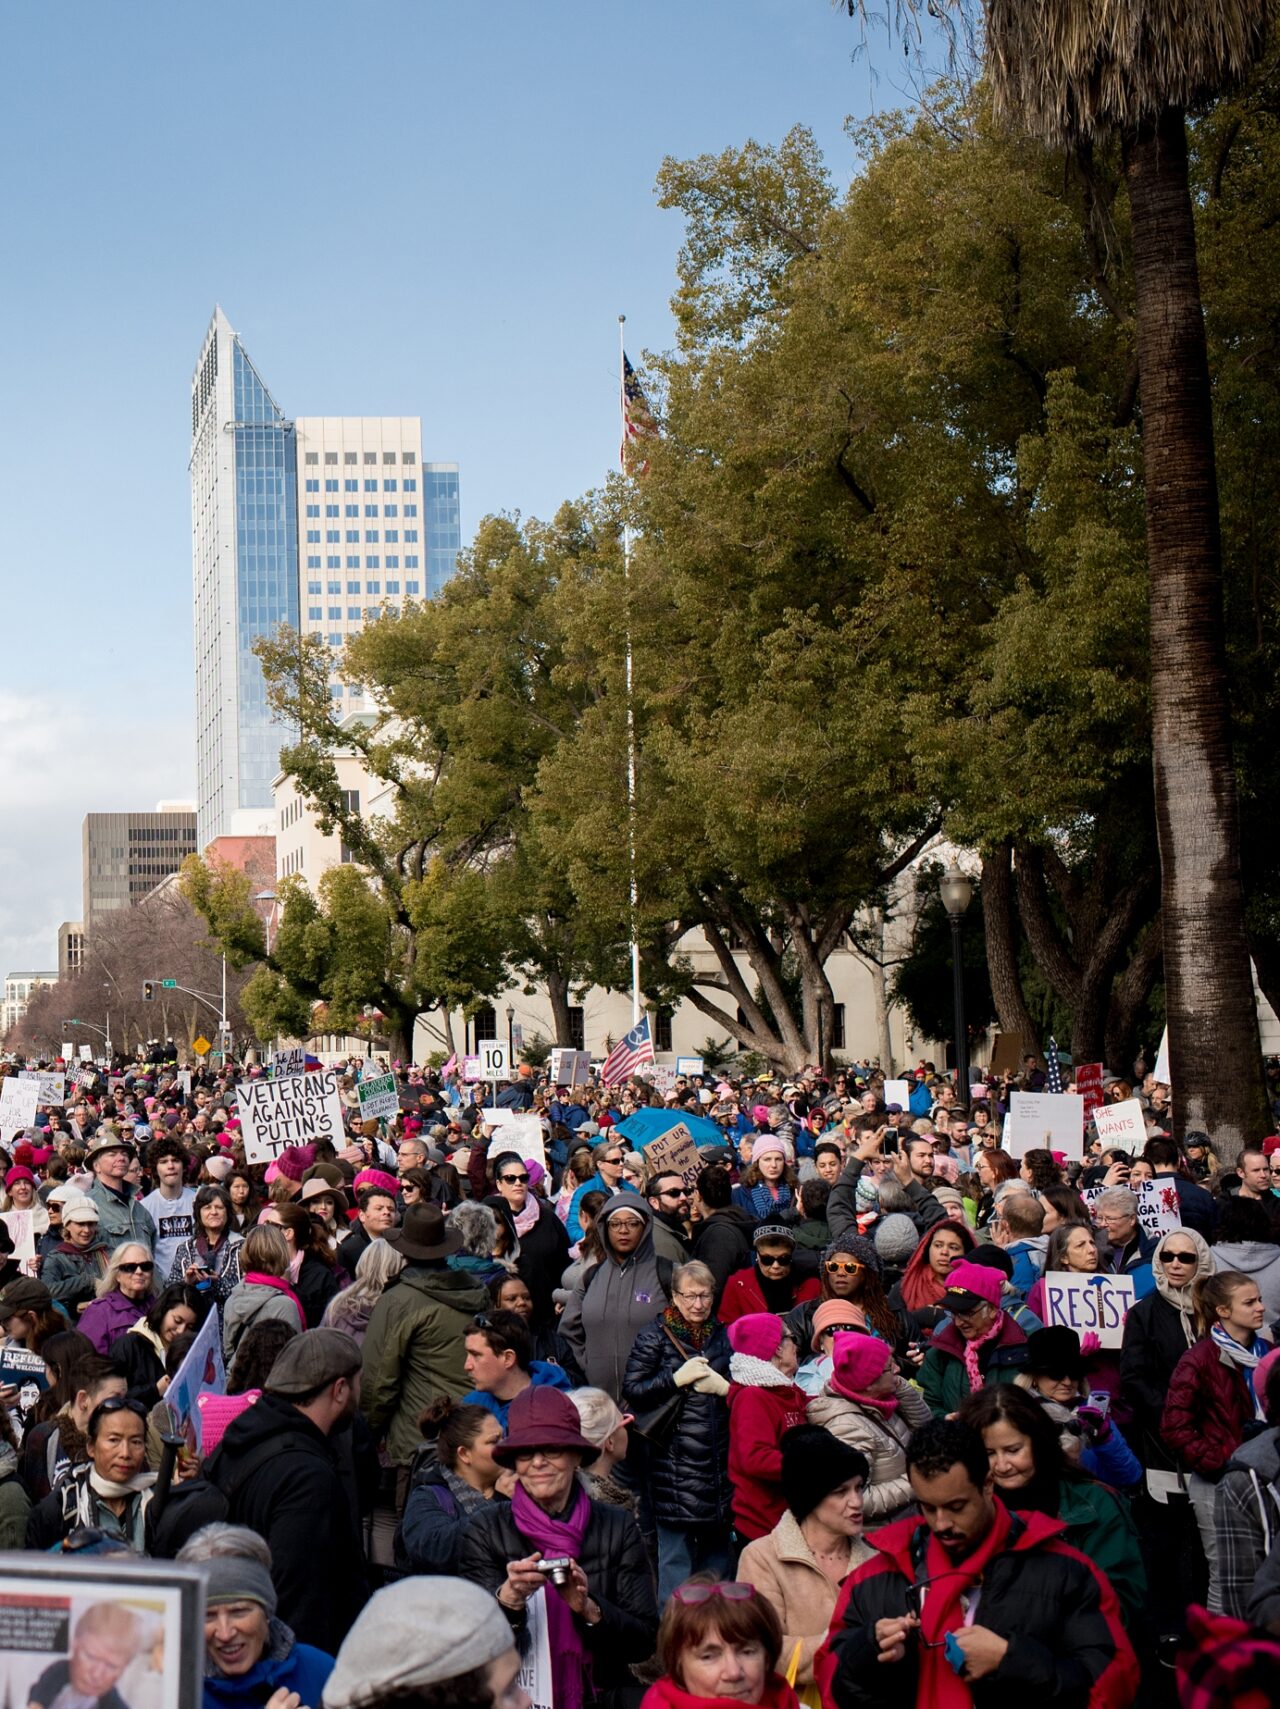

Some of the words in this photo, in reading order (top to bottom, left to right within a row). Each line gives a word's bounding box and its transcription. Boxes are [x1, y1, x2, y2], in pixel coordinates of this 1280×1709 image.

[485, 1050, 503, 1068] 10
[486, 1069, 503, 1077] MILES
[238, 1072, 336, 1106] VETERANS
[253, 1096, 329, 1124] AGAINST
[1095, 1106, 1114, 1119] SHE
[257, 1114, 333, 1143] PUTIN'S
[1100, 1119, 1135, 1136] WANTS
[651, 1138, 670, 1155] PUT
[672, 1127, 689, 1140] UR
[679, 1156, 690, 1166] the
[1142, 1182, 1154, 1191] IS
[4, 1351, 46, 1365] REFUG
